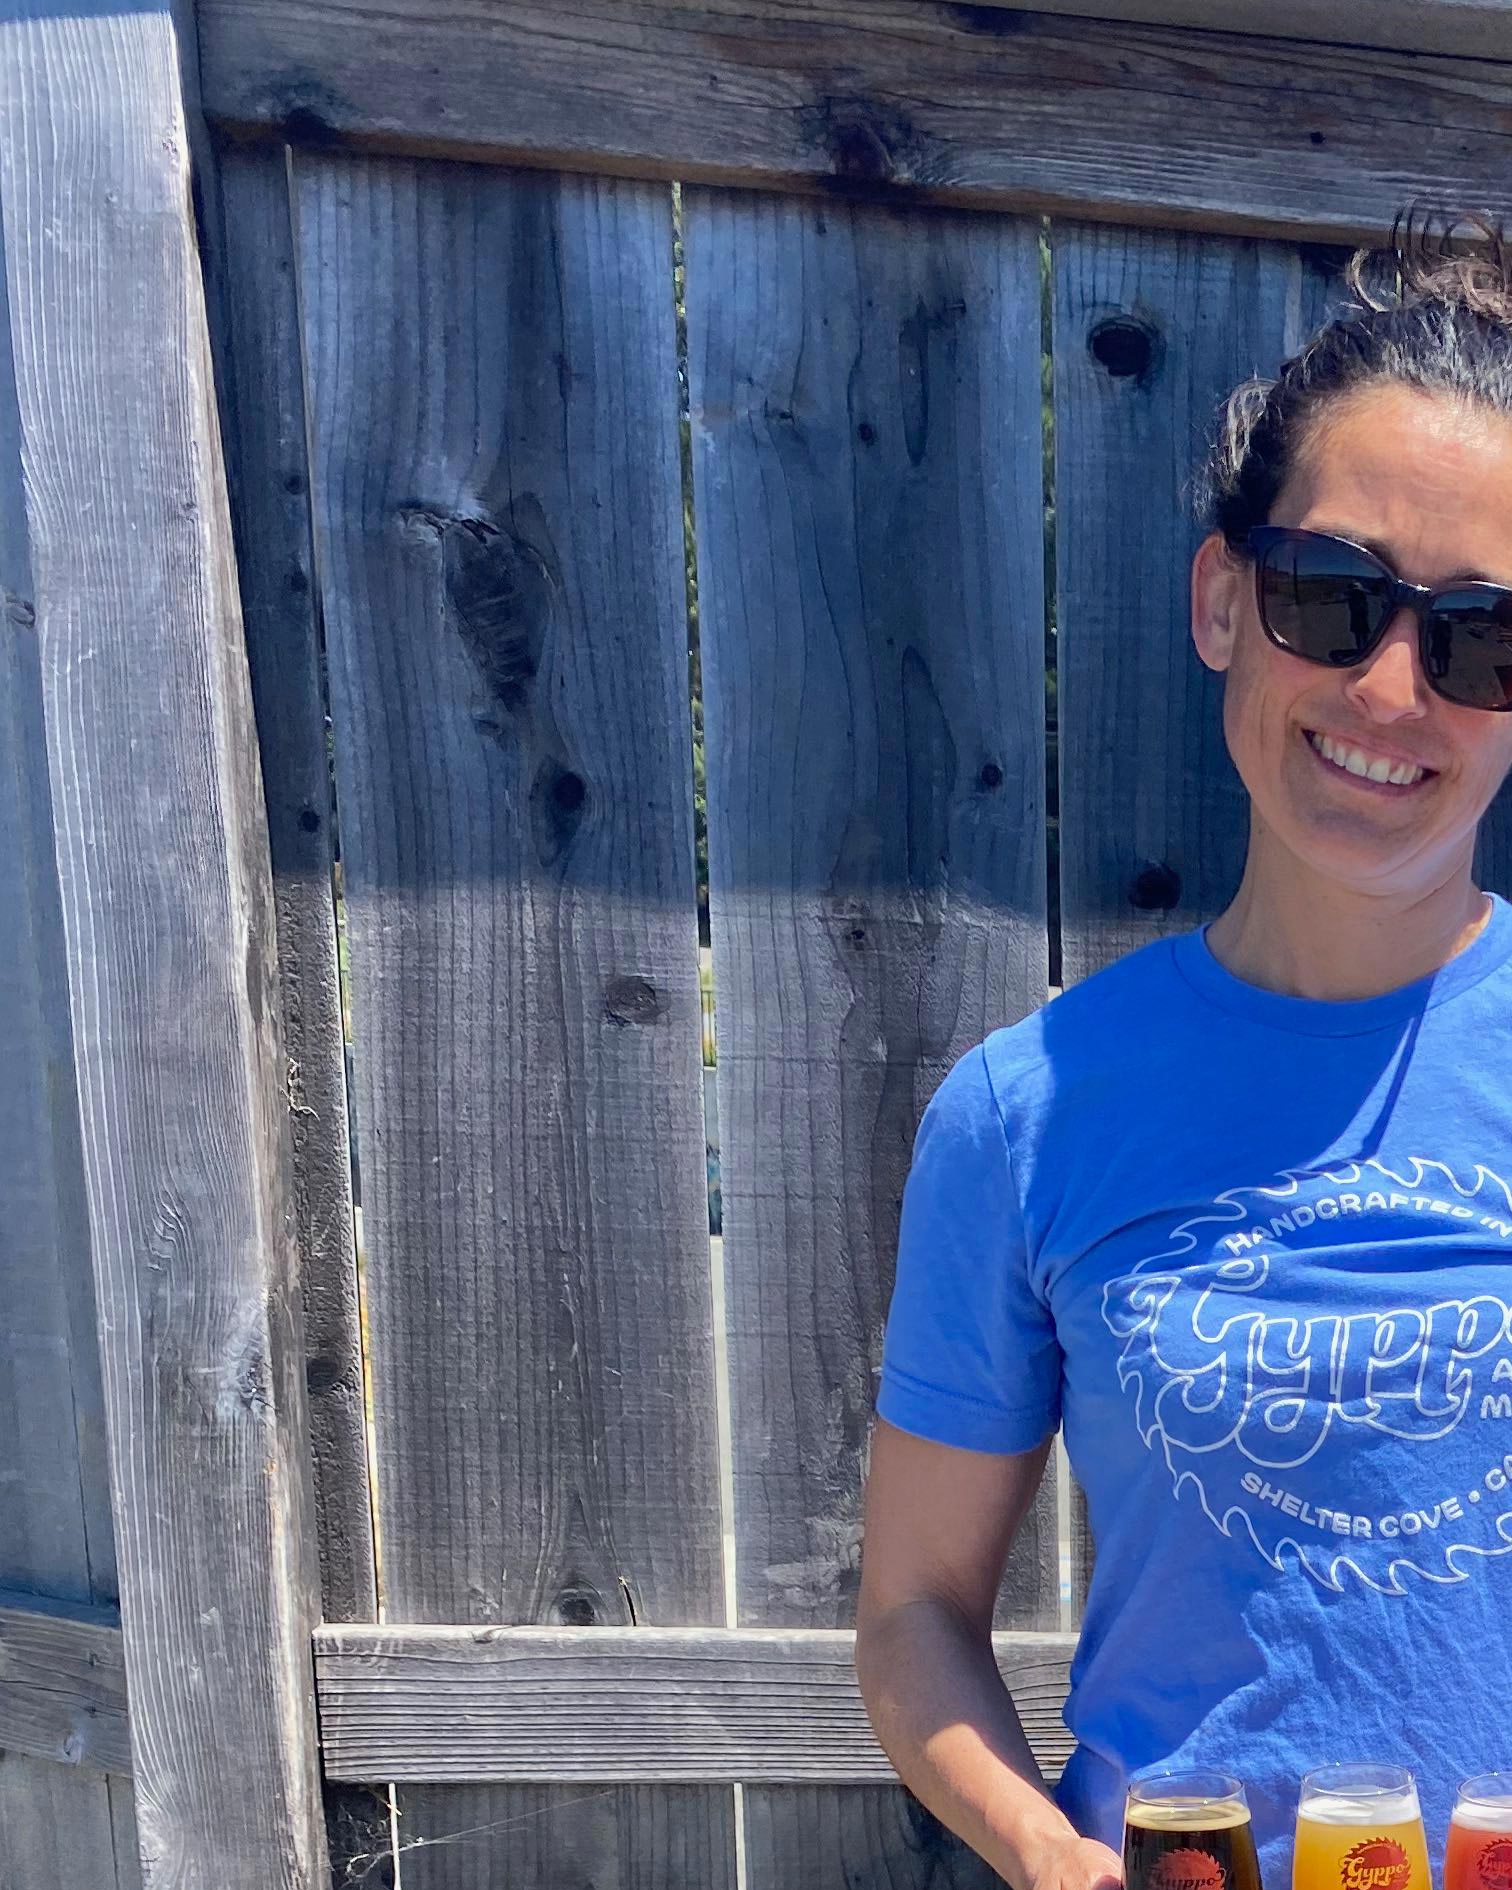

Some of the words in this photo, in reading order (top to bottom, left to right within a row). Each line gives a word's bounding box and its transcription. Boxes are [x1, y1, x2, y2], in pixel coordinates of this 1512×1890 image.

[1224, 1191, 1473, 1256] HANDCRAFTED
[1240, 1472, 1373, 1538] SHELTER
[1379, 1497, 1464, 1538] COVE
[1338, 1856, 1409, 1890] Gyppo
